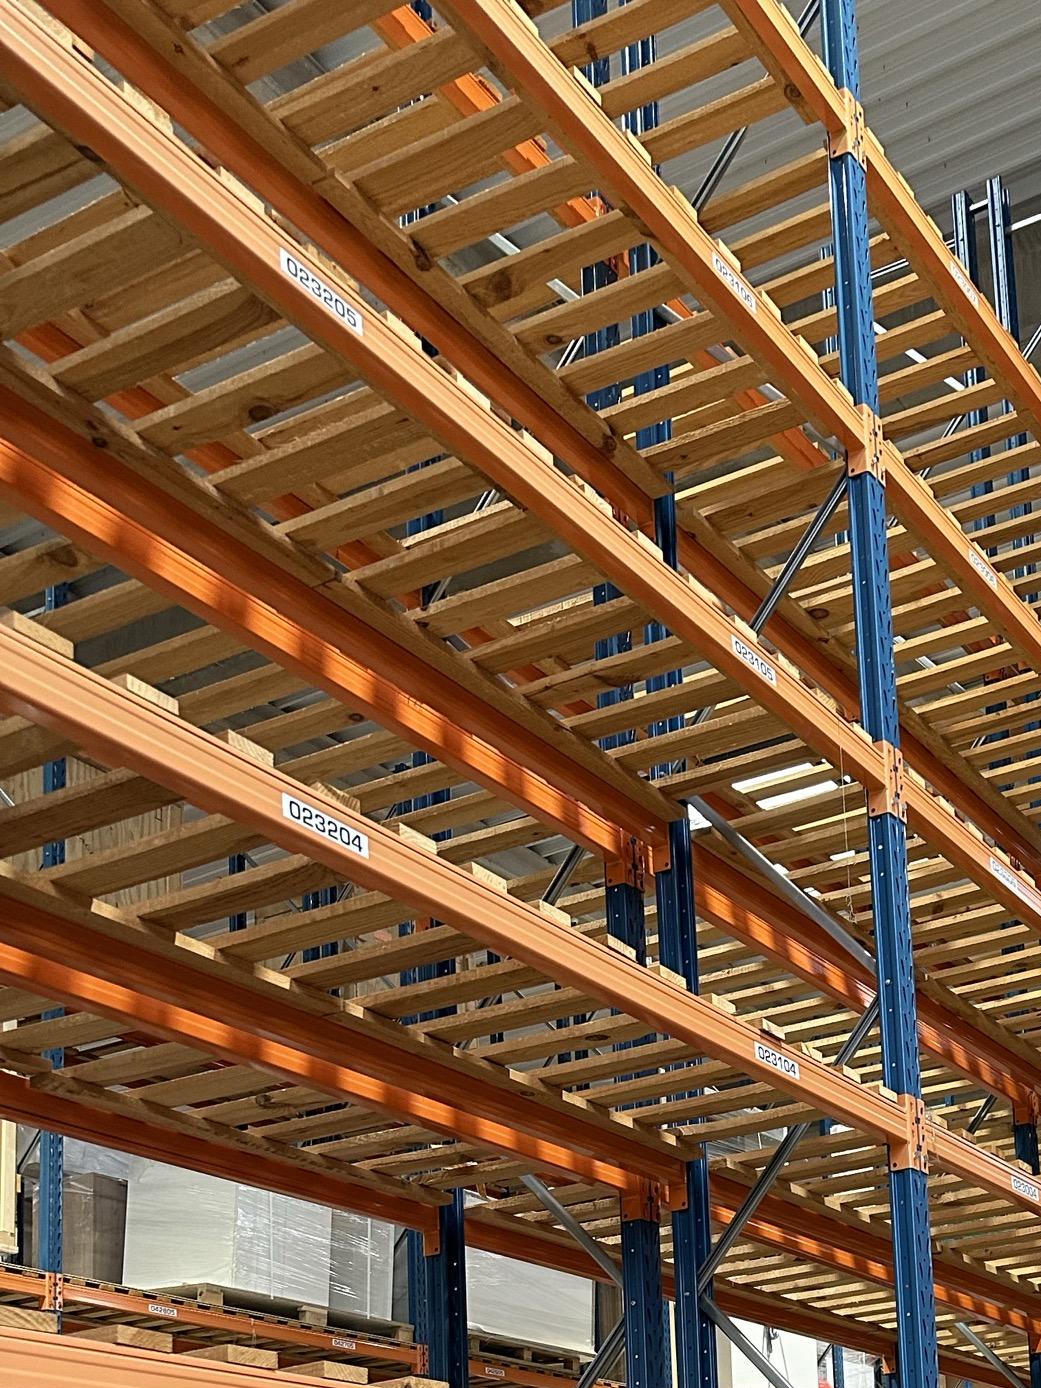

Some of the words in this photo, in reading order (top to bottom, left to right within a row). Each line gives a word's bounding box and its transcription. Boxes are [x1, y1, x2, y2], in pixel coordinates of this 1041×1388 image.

[286, 255, 358, 329] 023205
[735, 640, 774, 682] 023105
[289, 801, 363, 853] 023204
[758, 1046, 797, 1076] 023104
